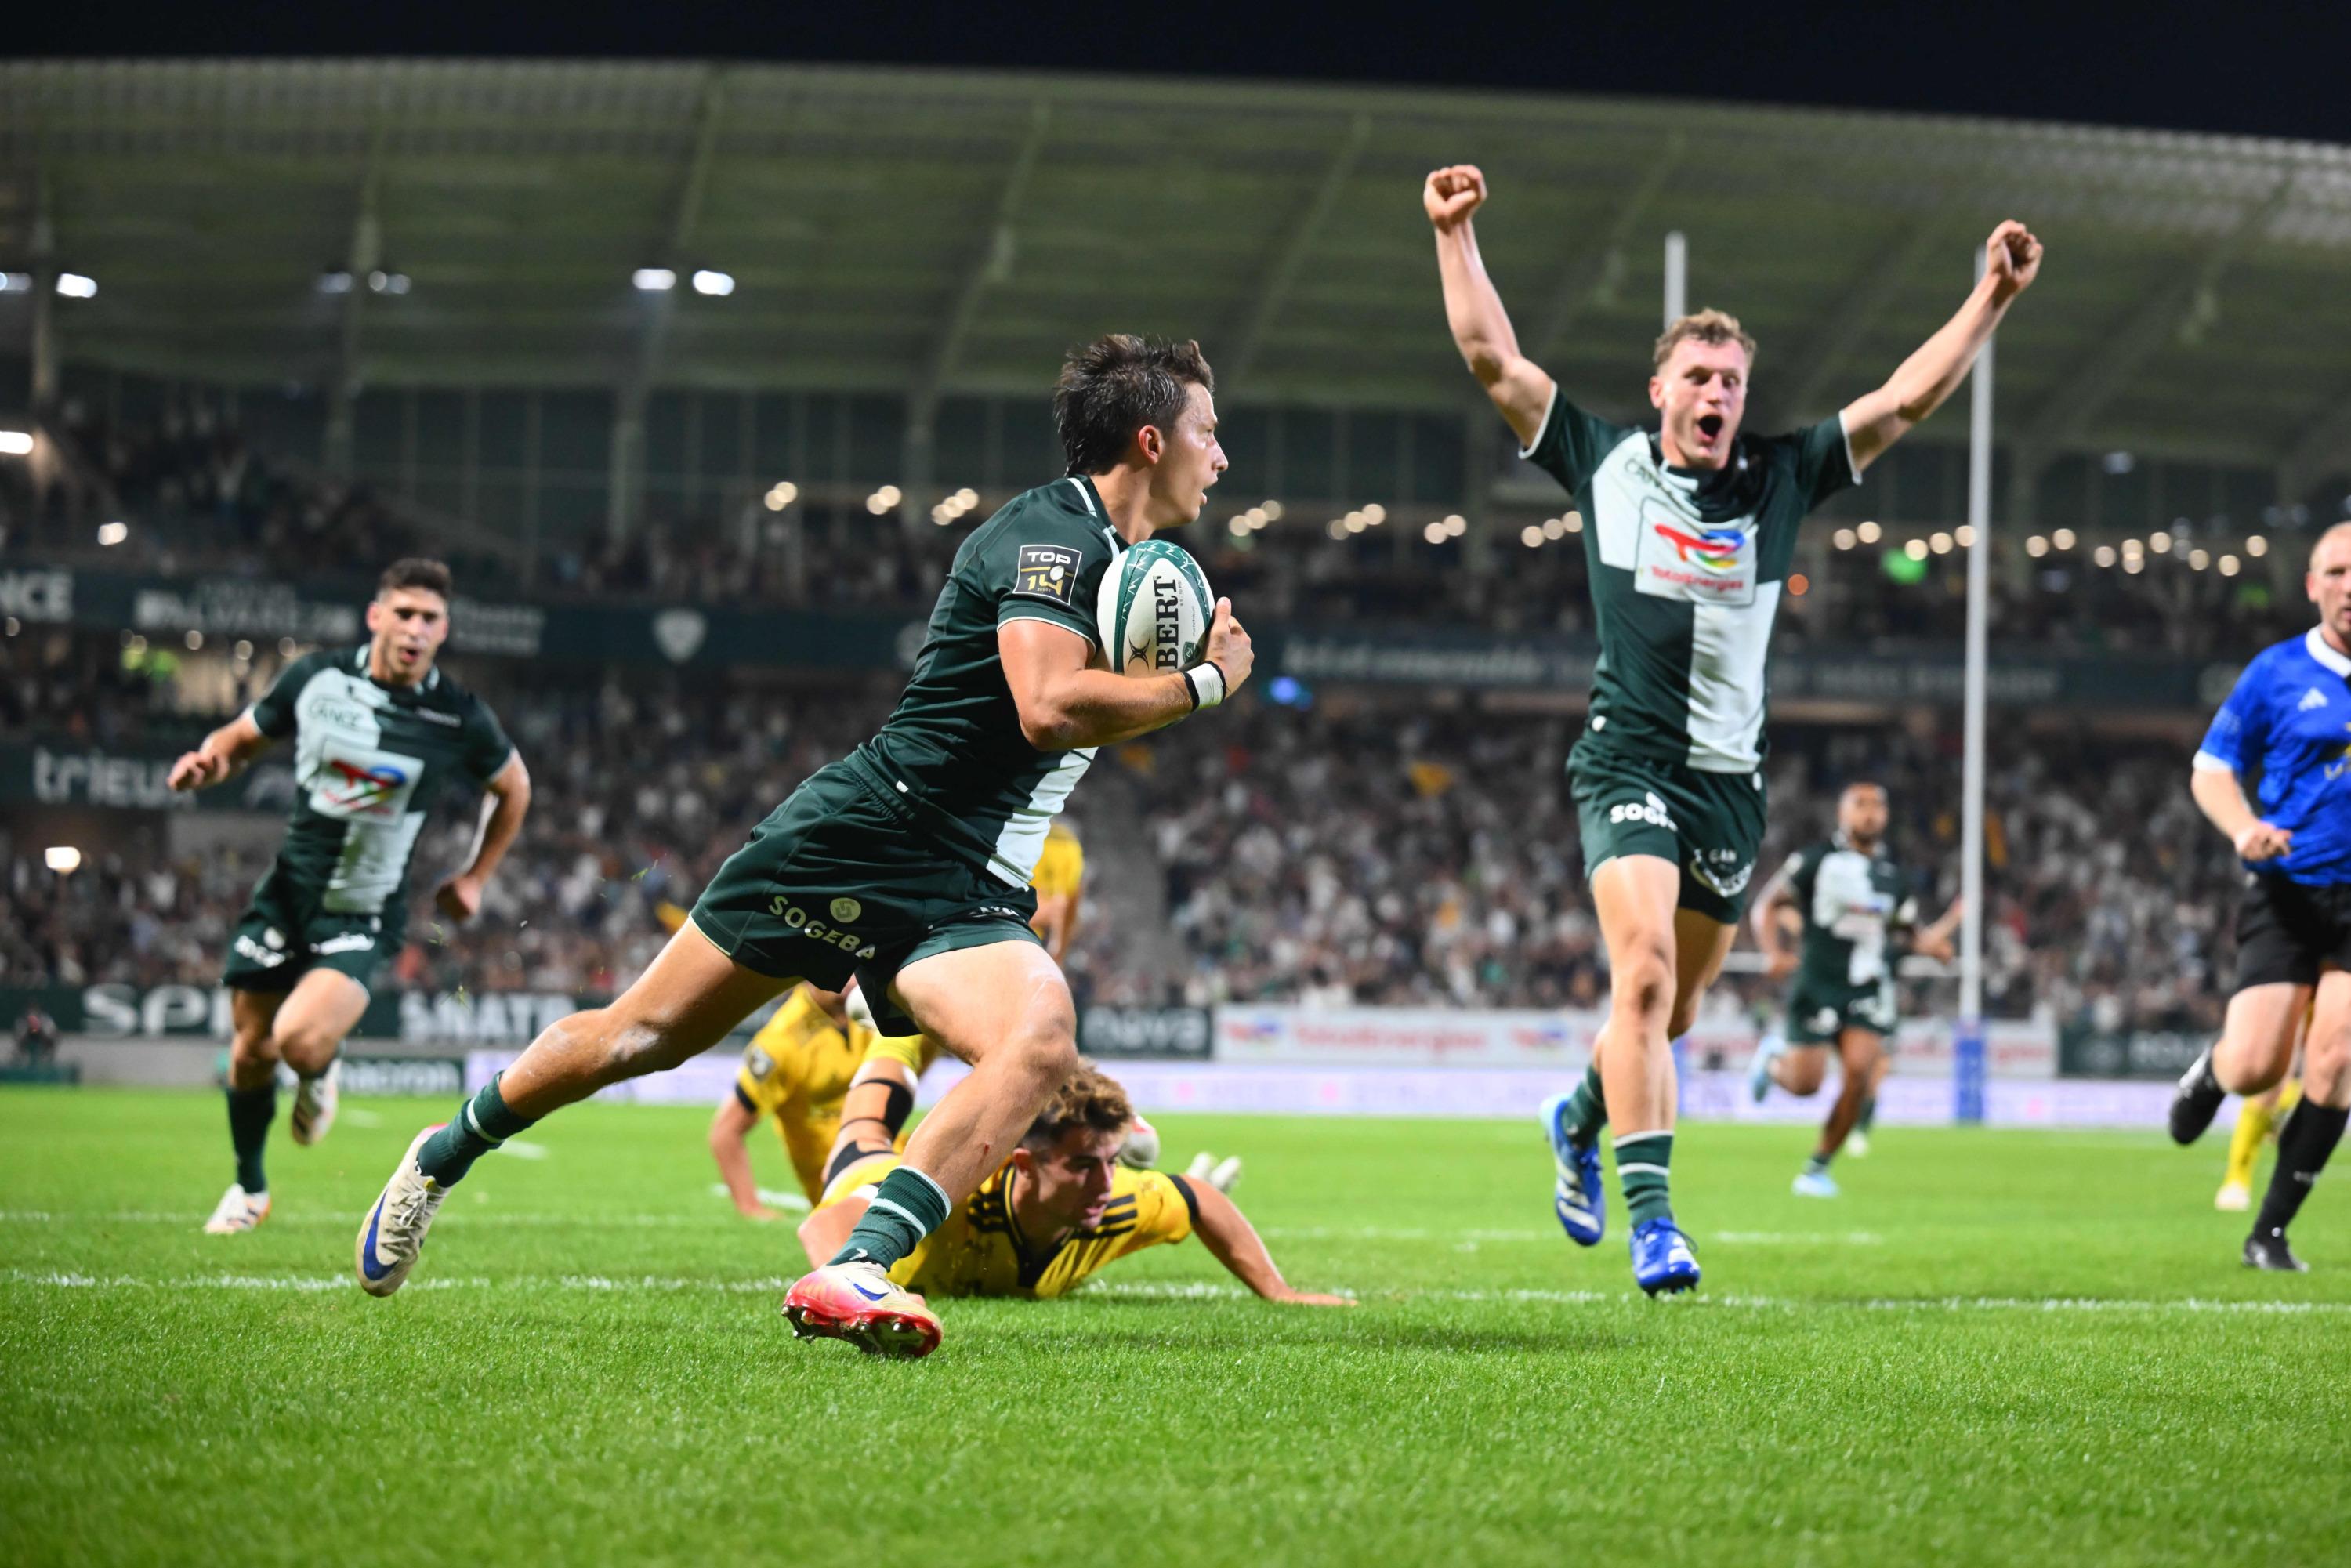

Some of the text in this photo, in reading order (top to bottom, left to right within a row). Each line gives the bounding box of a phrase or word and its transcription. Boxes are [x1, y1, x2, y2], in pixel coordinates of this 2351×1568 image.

[1027, 552, 1071, 564] TOP
[1027, 574, 1063, 596] 14
[1154, 576, 1179, 670] BERT
[768, 896, 875, 960] SOGEBA
